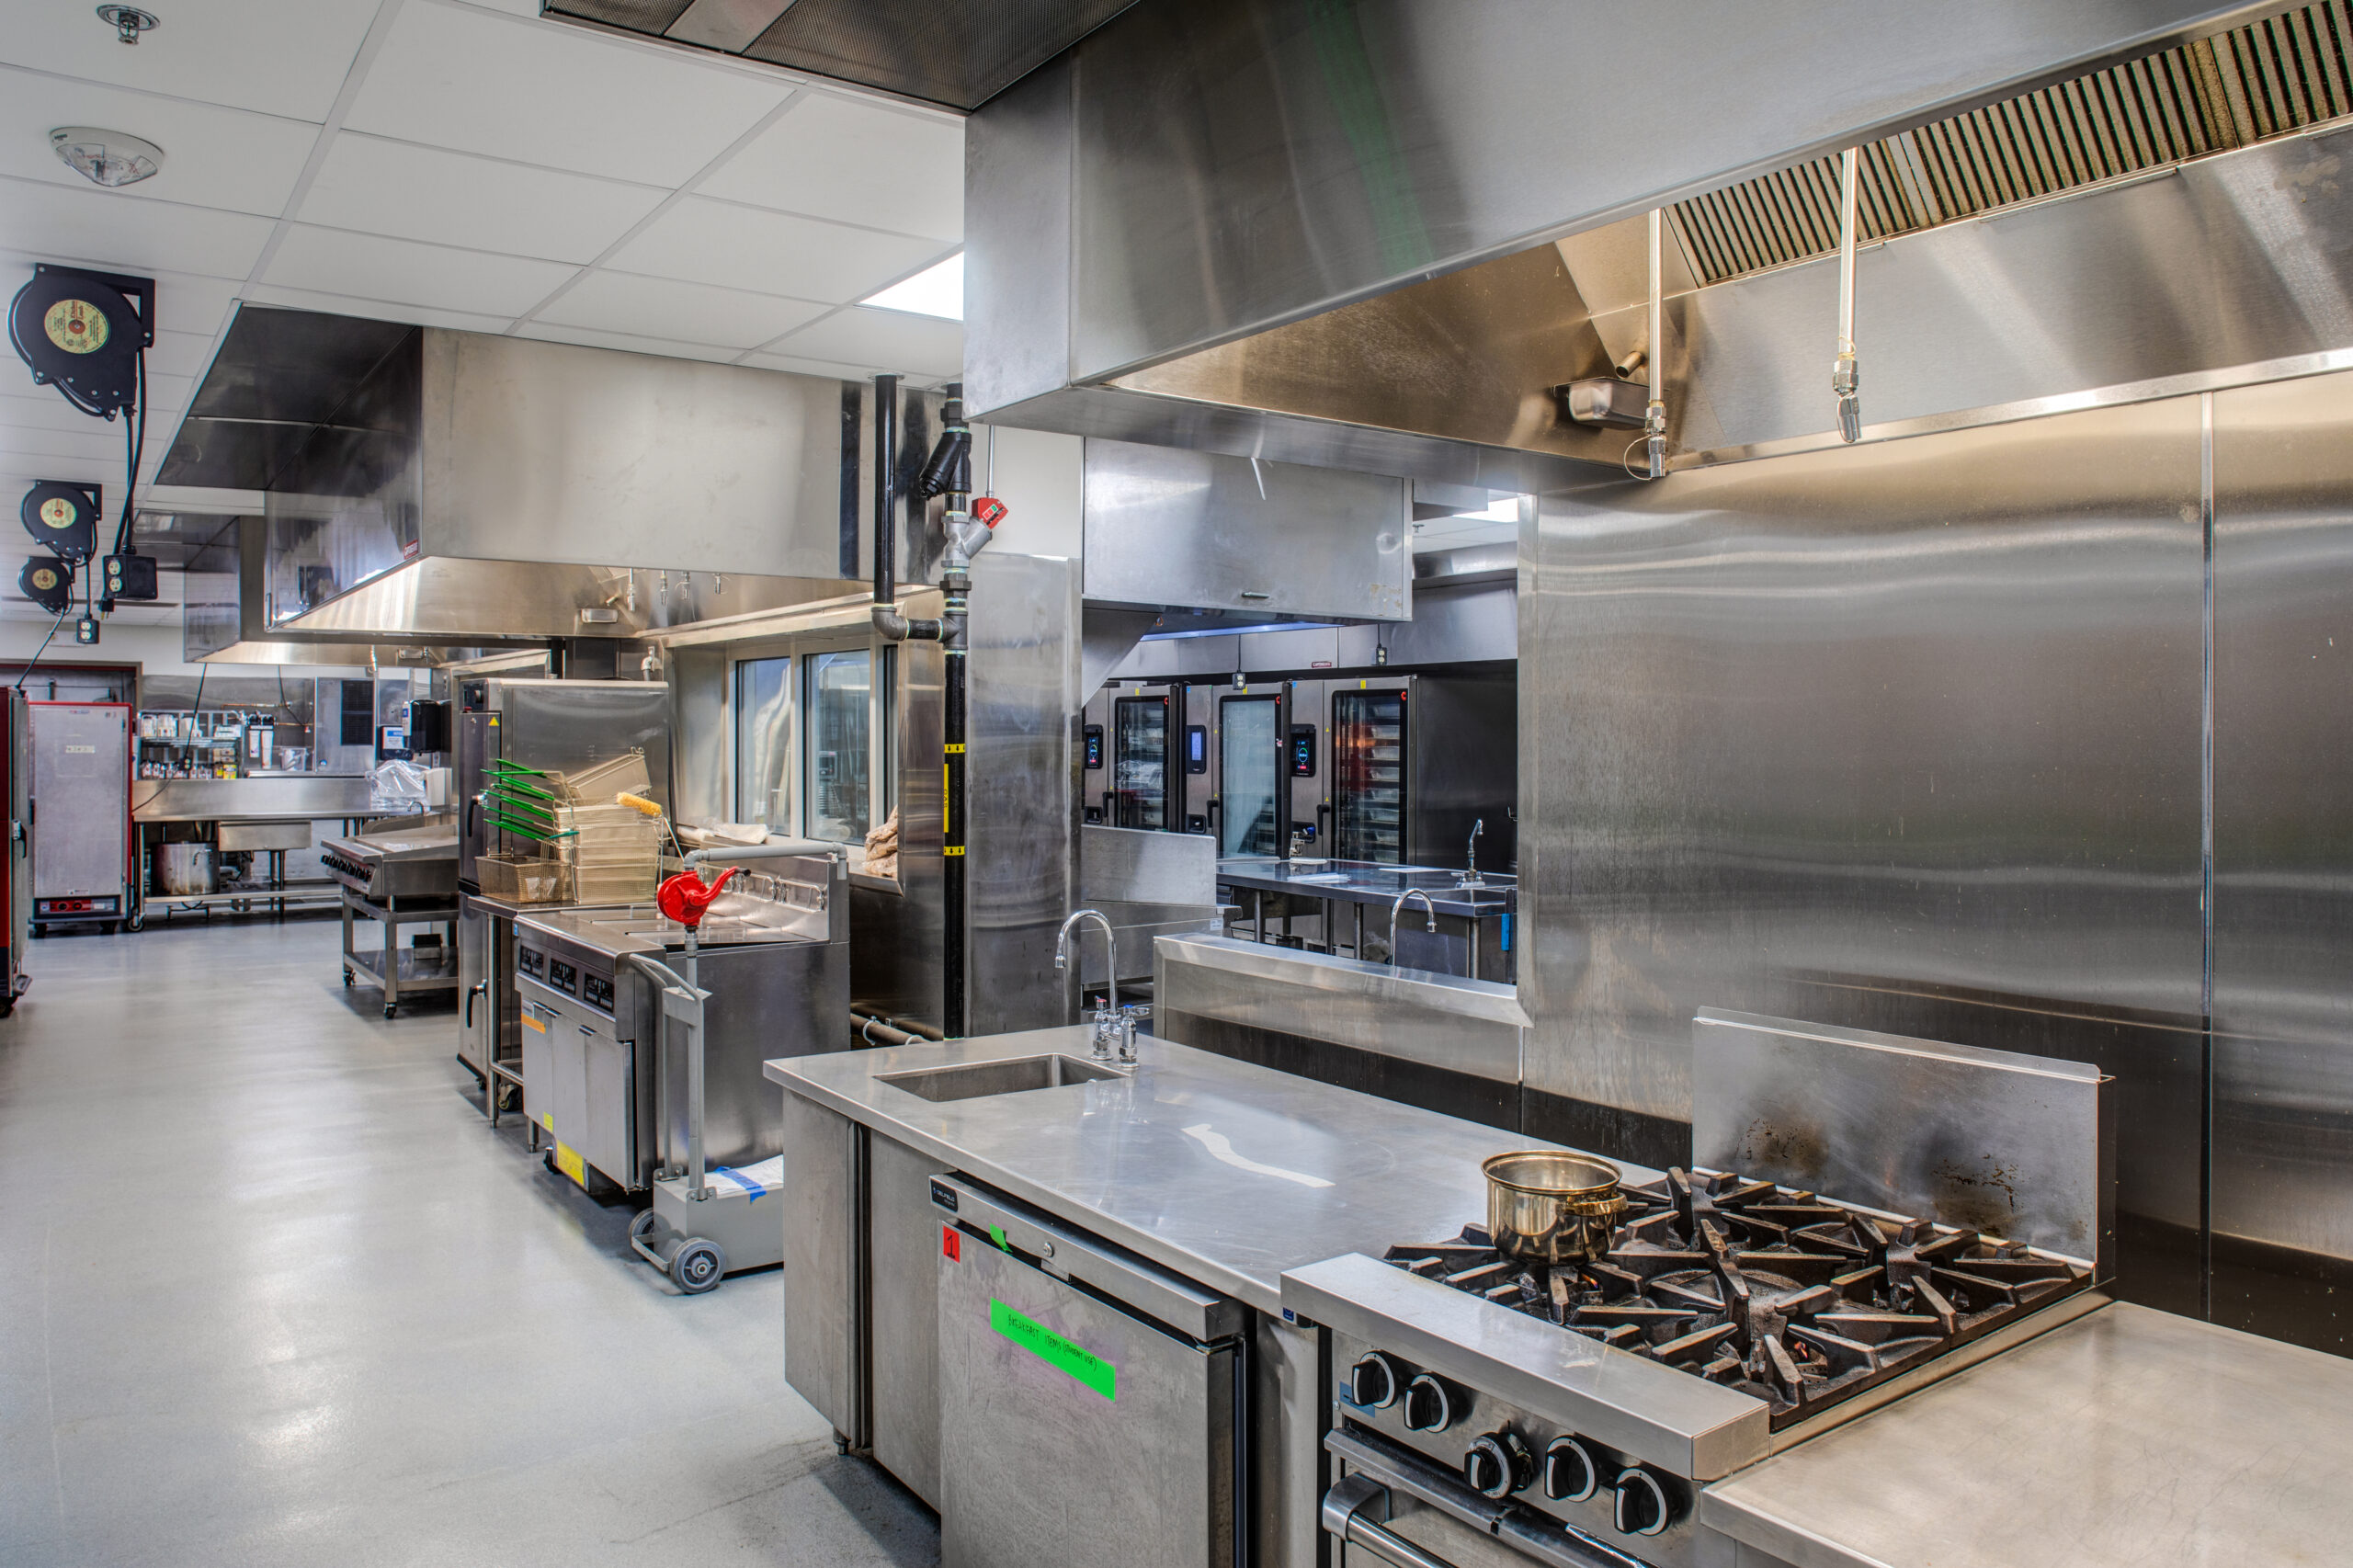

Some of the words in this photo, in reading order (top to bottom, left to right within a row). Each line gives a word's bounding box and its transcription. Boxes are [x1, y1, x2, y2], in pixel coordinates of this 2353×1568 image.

[947, 1234, 956, 1259] 1
[1007, 1313, 1040, 1341] BREAKFAST
[1044, 1334, 1062, 1353] ITEMS
[1085, 1354, 1097, 1372] USE)
